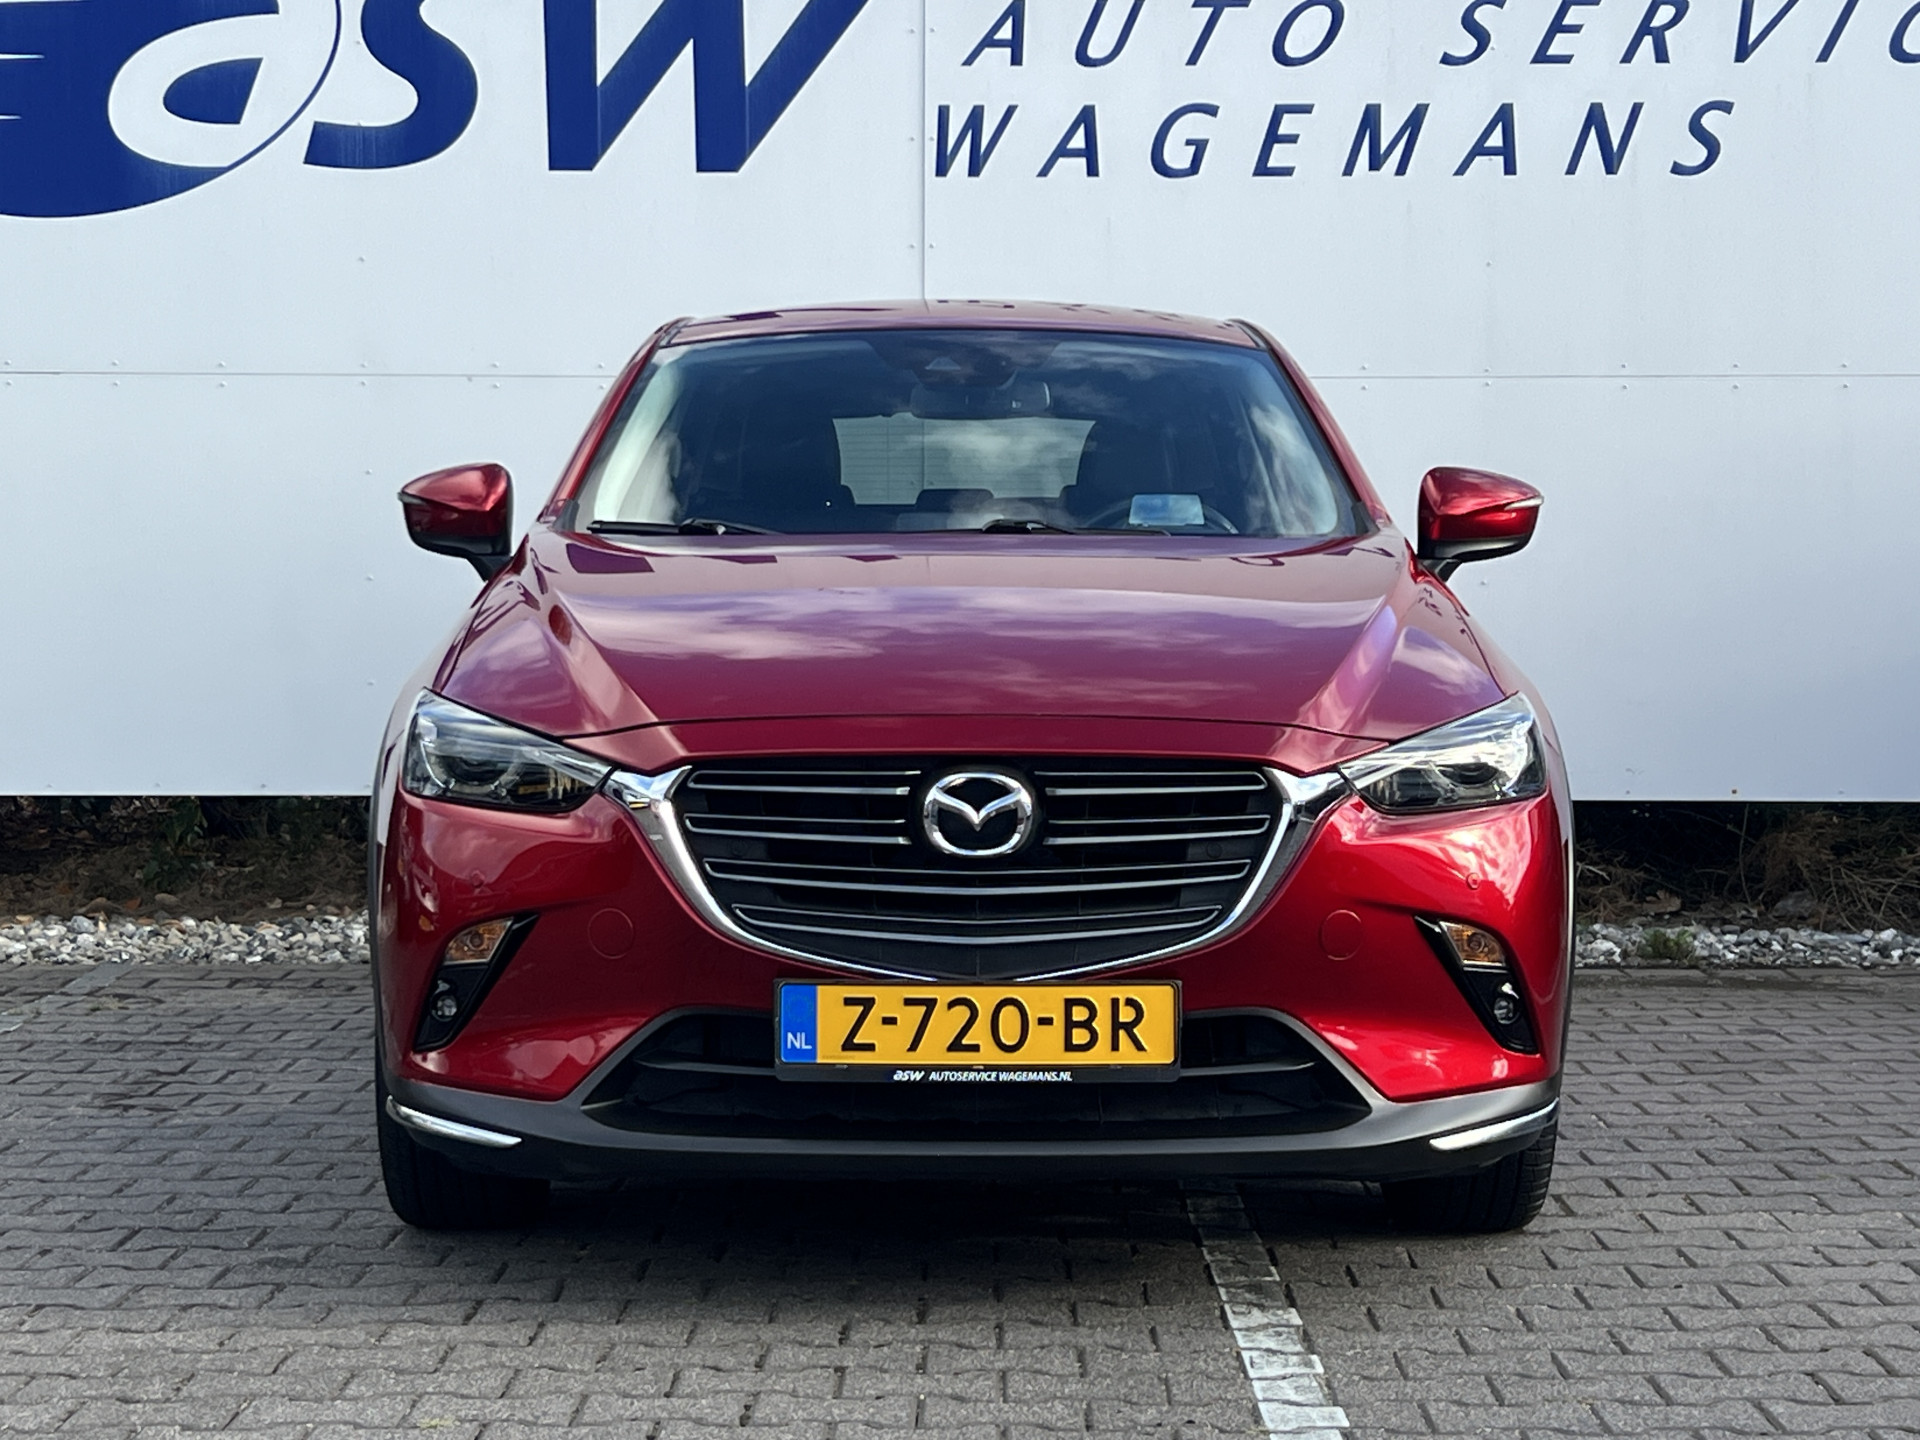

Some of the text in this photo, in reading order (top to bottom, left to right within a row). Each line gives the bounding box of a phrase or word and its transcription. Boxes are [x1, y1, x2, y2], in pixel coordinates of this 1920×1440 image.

[962, 0, 1345, 68] AUTO
[934, 101, 1735, 179] WAGEMANS
[786, 1032, 813, 1050] NL
[841, 996, 1147, 1054] Z-720-BR
[928, 1070, 998, 1082] AUTOSERVICE
[999, 1070, 1073, 1082] WAGEMANS.NL
